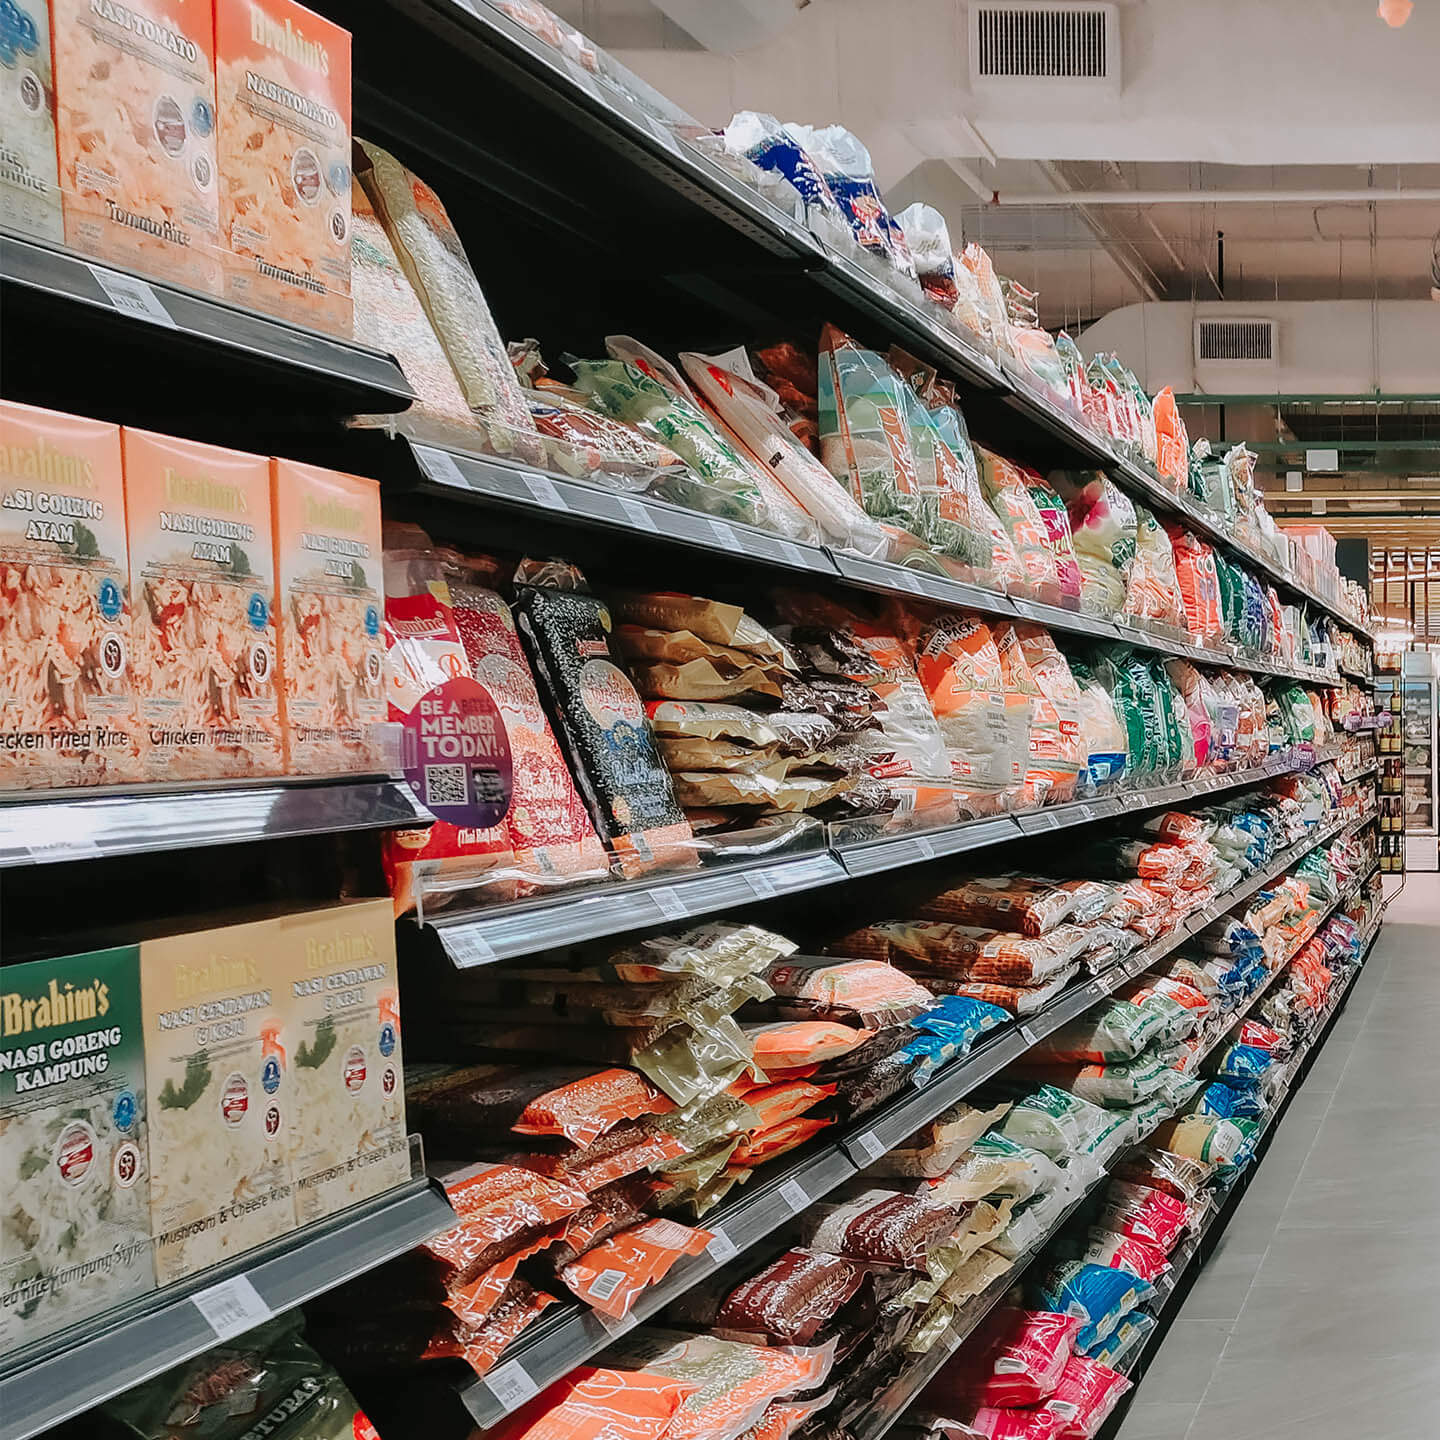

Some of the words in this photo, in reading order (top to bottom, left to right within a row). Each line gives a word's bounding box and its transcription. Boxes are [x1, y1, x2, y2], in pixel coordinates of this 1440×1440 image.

[131, 14, 197, 63] TOMATO
[0, 489, 34, 511] ASI
[25, 520, 75, 544] AYAM
[193, 541, 232, 564] AYAM
[420, 700, 444, 715] BE
[448, 700, 460, 714] A
[97, 726, 129, 747] Rice
[150, 724, 206, 747] Chicken
[421, 715, 496, 735] MEMBER
[422, 735, 498, 758] TODAY!
[0, 978, 110, 1037] Brahim's
[0, 1043, 46, 1072] NASI
[50, 1026, 122, 1060] GORENG
[15, 1053, 109, 1093] KAMPUNG
[158, 1214, 215, 1249] Mushroom
